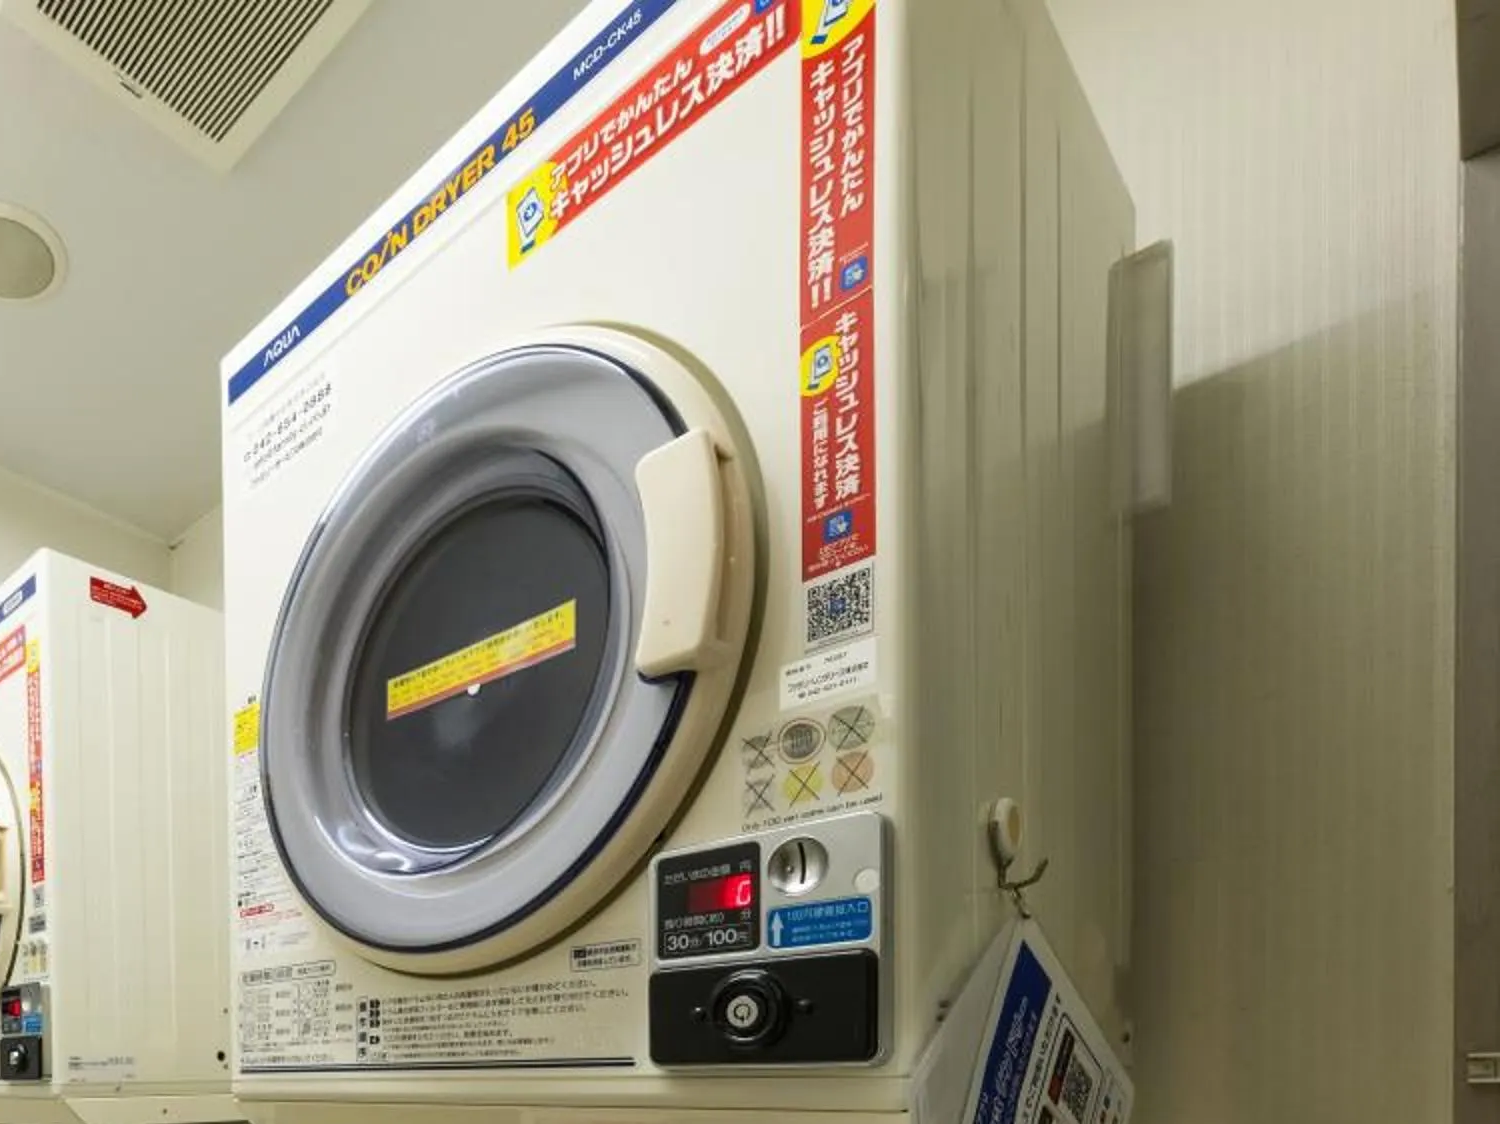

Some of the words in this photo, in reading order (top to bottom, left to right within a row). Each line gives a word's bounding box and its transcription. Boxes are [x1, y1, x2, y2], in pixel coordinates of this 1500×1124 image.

[572, 8, 642, 81] MCD-CK45
[412, 144, 496, 237] DRYER
[501, 107, 536, 152] 45
[549, 3, 786, 220] キャッシュレス決済!!
[550, 57, 693, 190] アプリでかんたん
[840, 33, 864, 219] アプリでかんたん
[263, 324, 300, 368] AQUA
